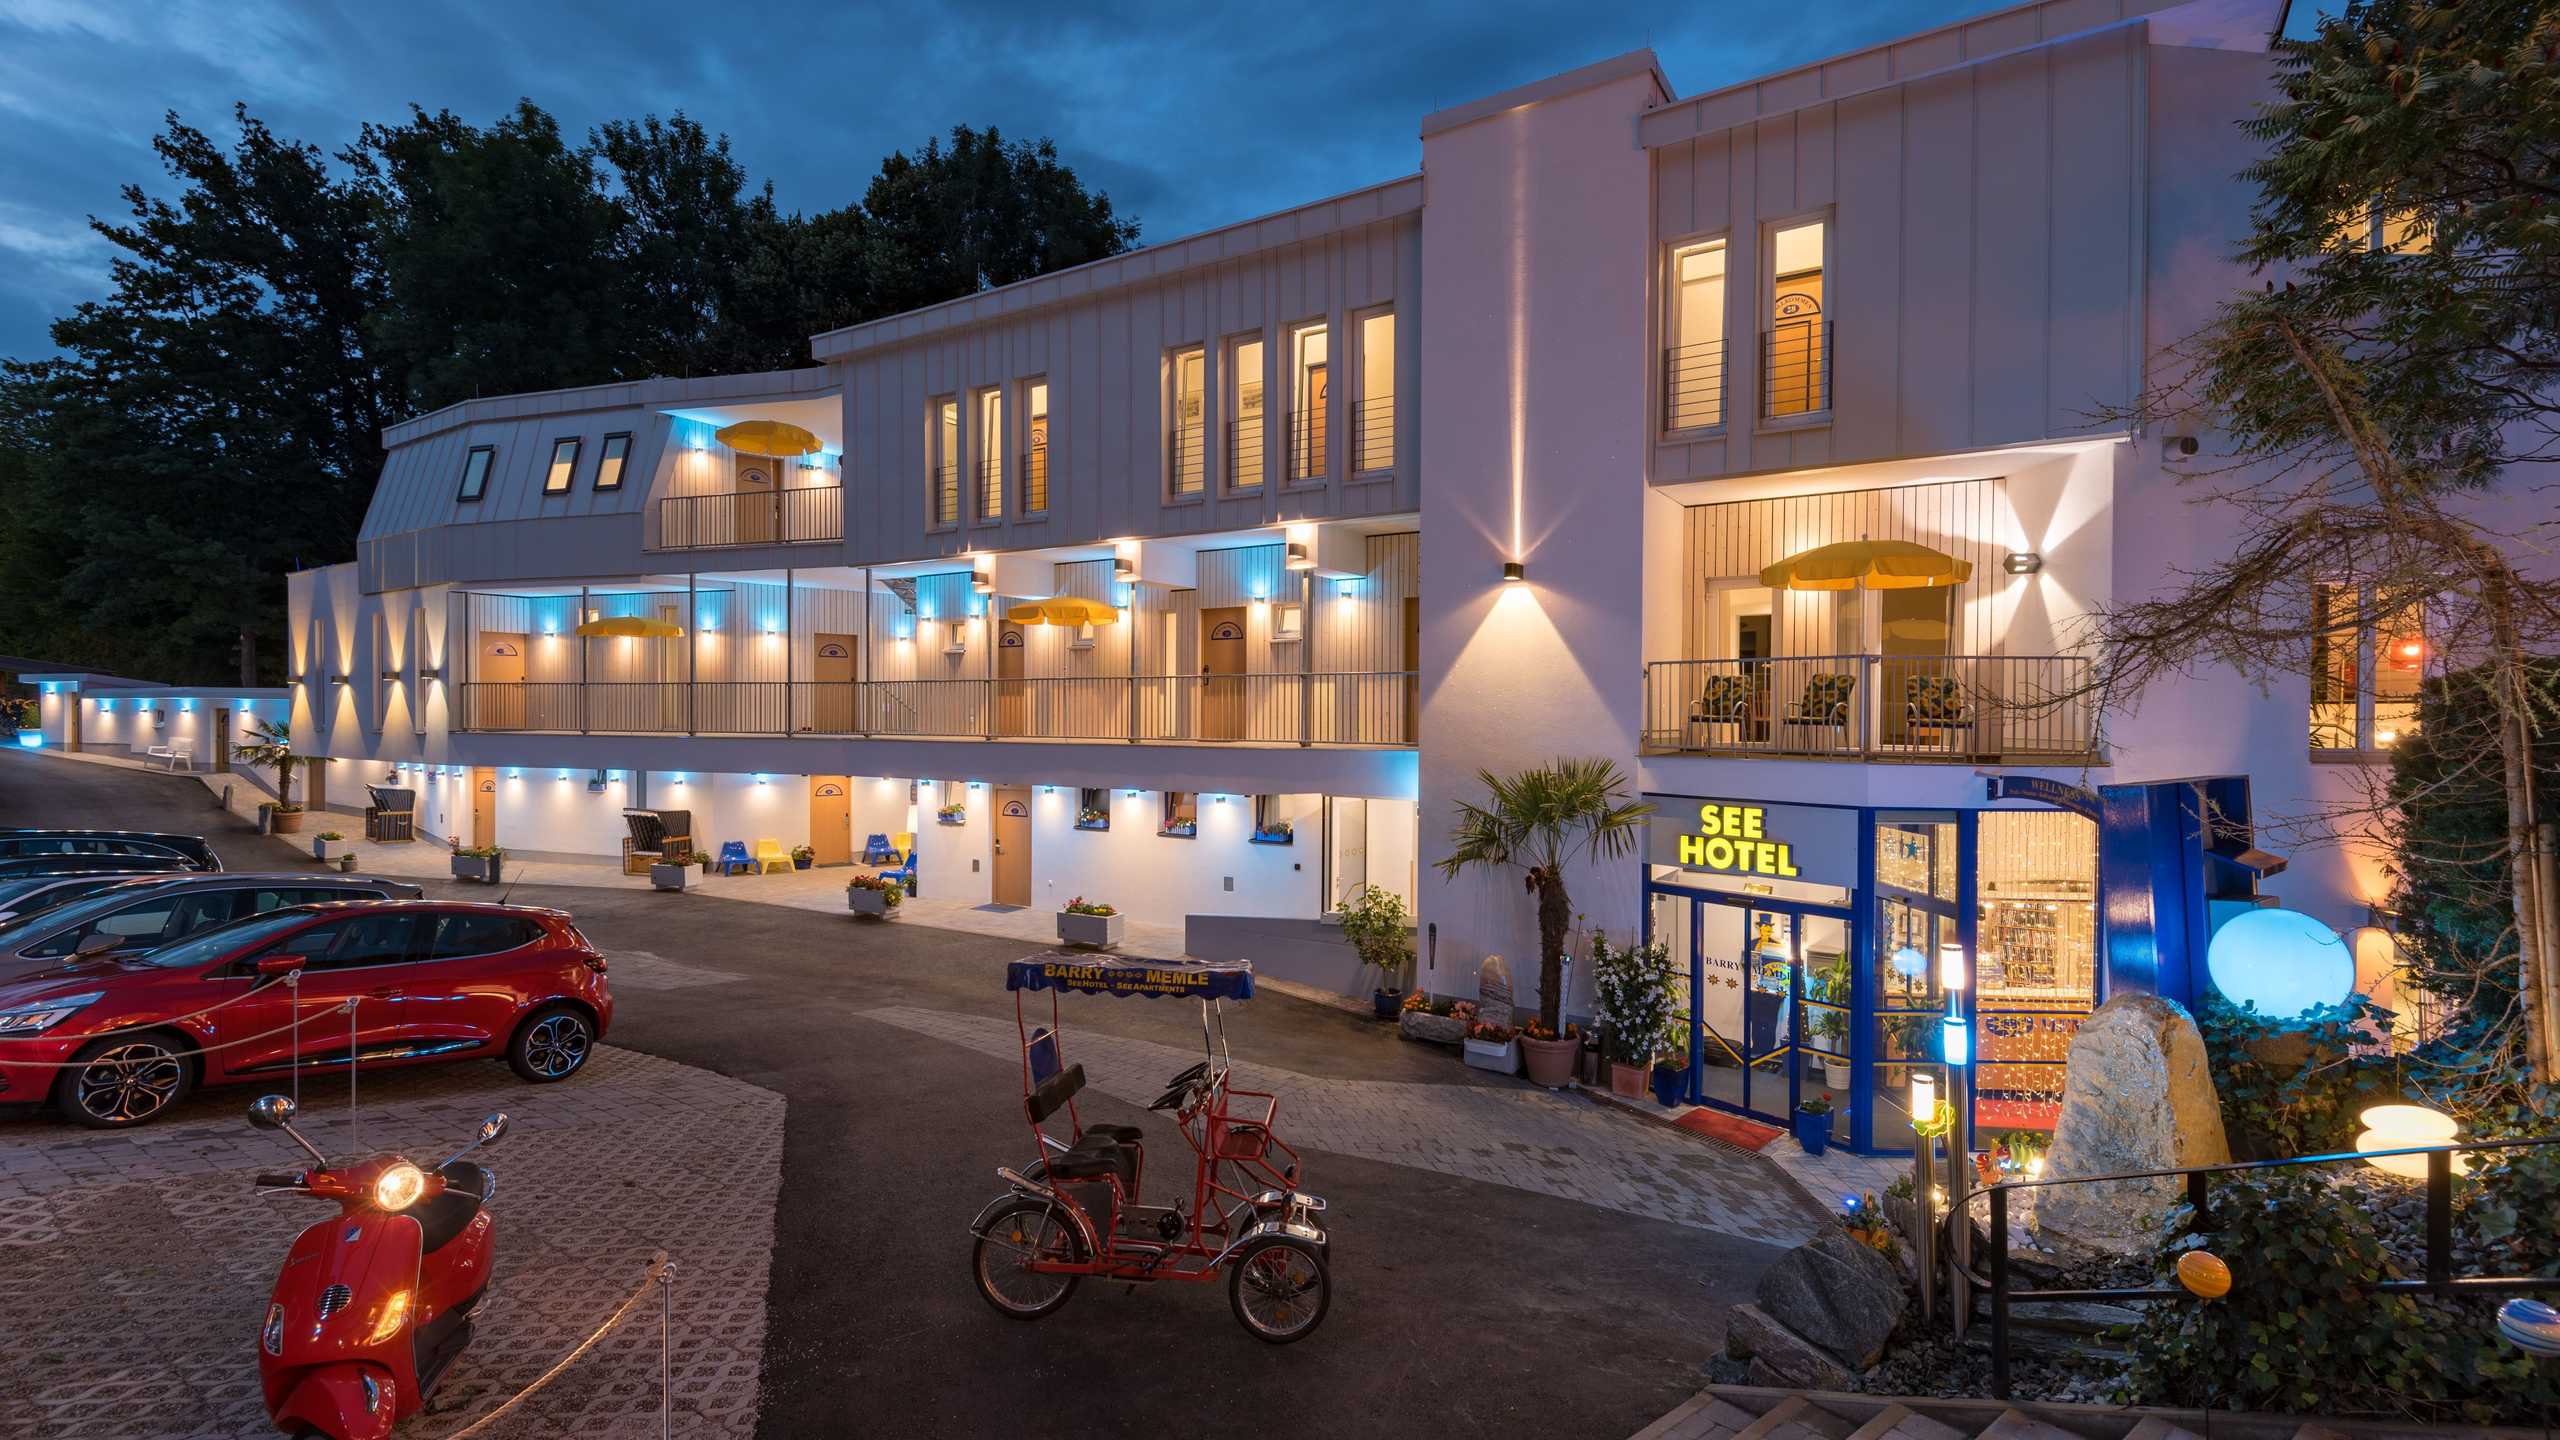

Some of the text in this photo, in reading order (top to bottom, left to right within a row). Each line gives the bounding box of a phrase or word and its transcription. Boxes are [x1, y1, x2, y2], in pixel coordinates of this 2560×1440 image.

[2031, 779, 2081, 802] WELLNESS
[1700, 804, 1766, 839] SEE
[1679, 834, 1799, 878] HOTEL
[1044, 963, 1209, 986] BARRY MEMLE
[1705, 956, 1740, 971] BARRY
